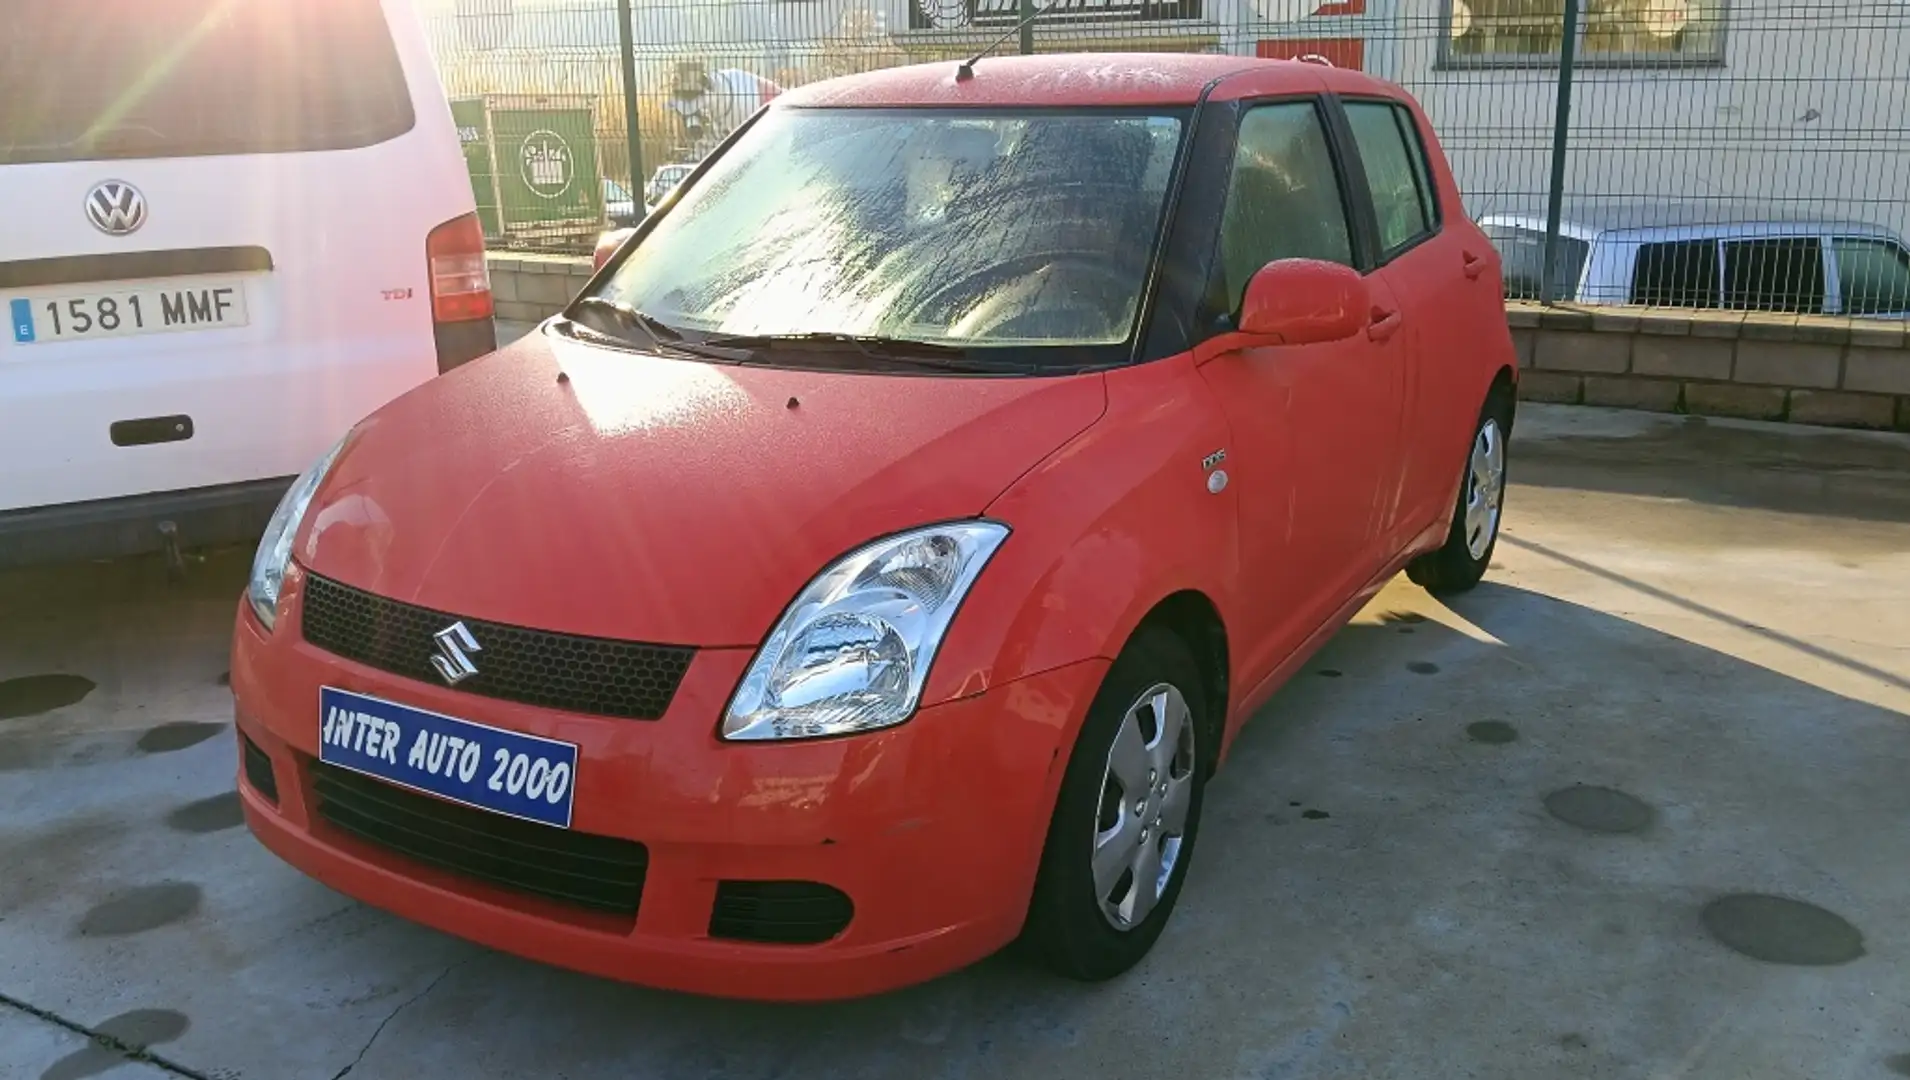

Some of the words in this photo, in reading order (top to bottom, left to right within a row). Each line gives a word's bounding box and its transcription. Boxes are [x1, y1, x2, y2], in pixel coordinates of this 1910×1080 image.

[87, 181, 145, 234] VW
[46, 294, 143, 335] 1581
[160, 287, 233, 326] MMF
[380, 287, 413, 300] TDI
[20, 324, 29, 336] E
[323, 705, 401, 765] INTER
[407, 729, 481, 783] AUTO
[488, 748, 570, 805] 2000
